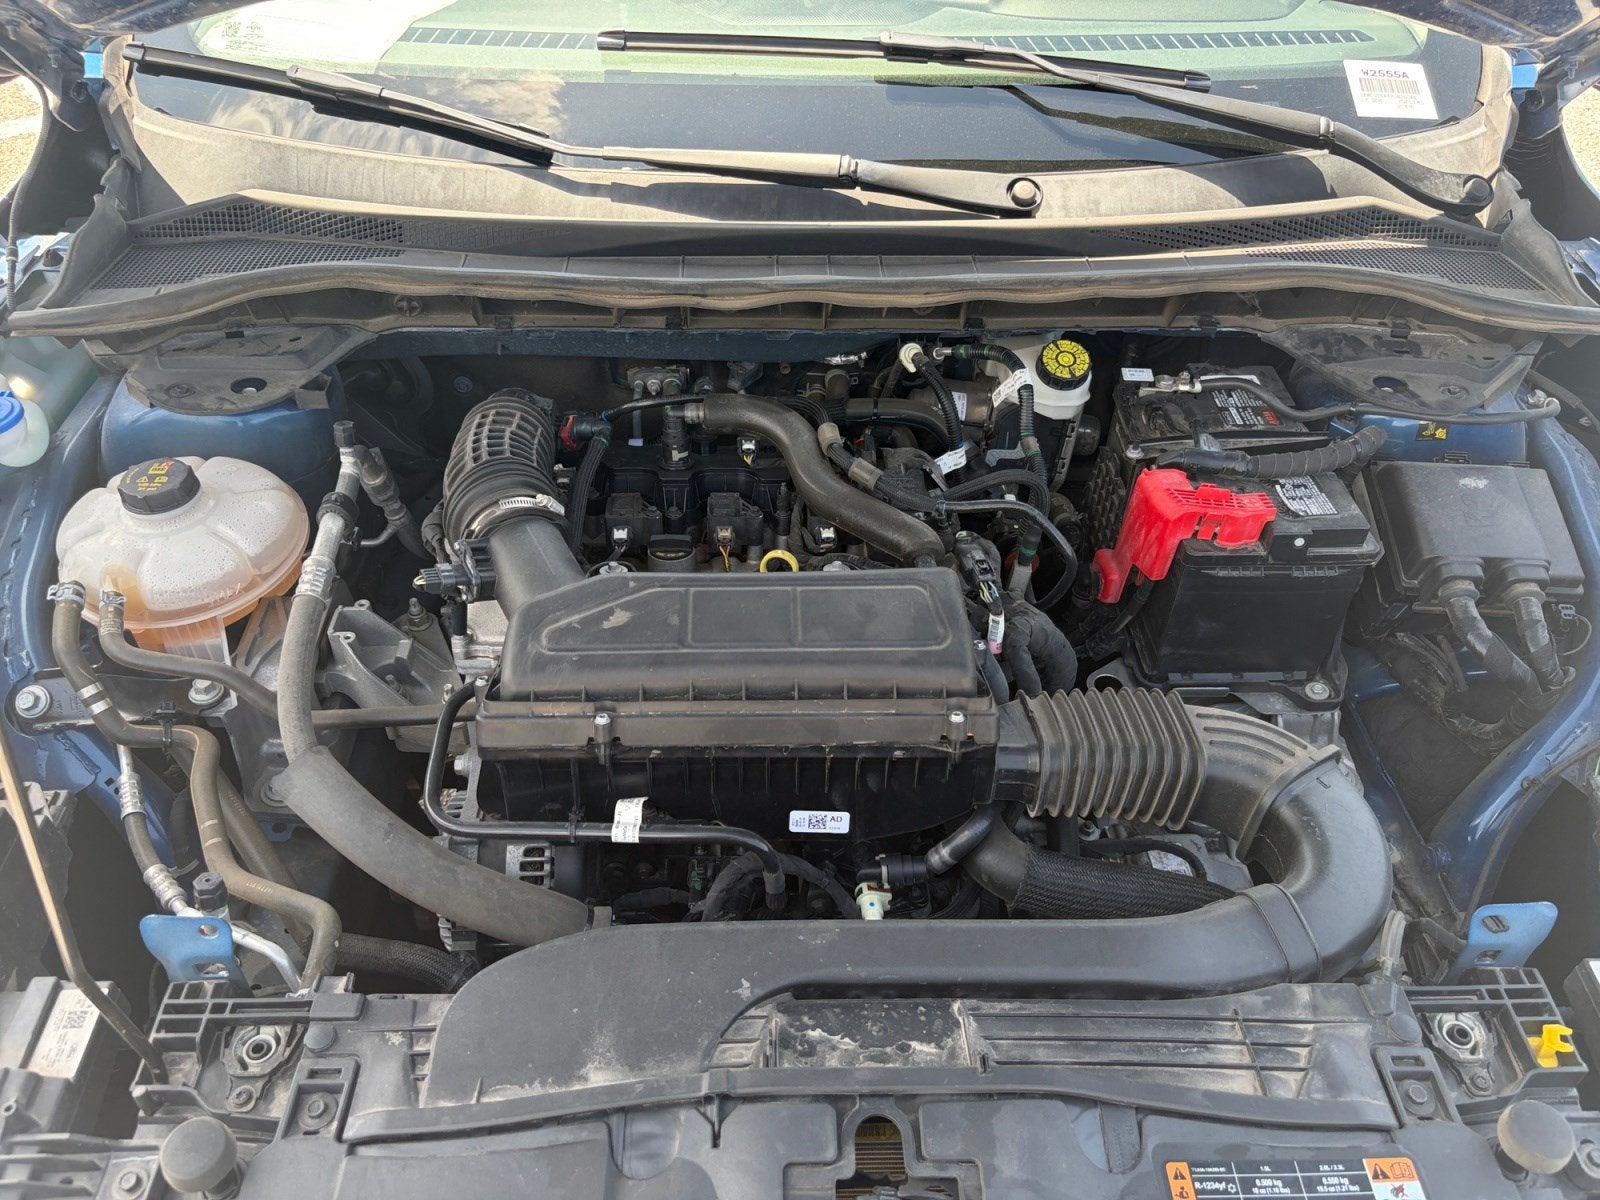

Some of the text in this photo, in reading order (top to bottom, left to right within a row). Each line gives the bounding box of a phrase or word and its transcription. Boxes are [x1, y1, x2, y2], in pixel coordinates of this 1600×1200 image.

[1361, 68, 1409, 79] W2555A
[1255, 1178, 1283, 1188] 0.500 kg
[1339, 1176, 1349, 1185] kg
[1194, 1181, 1226, 1191] R-1234yf
